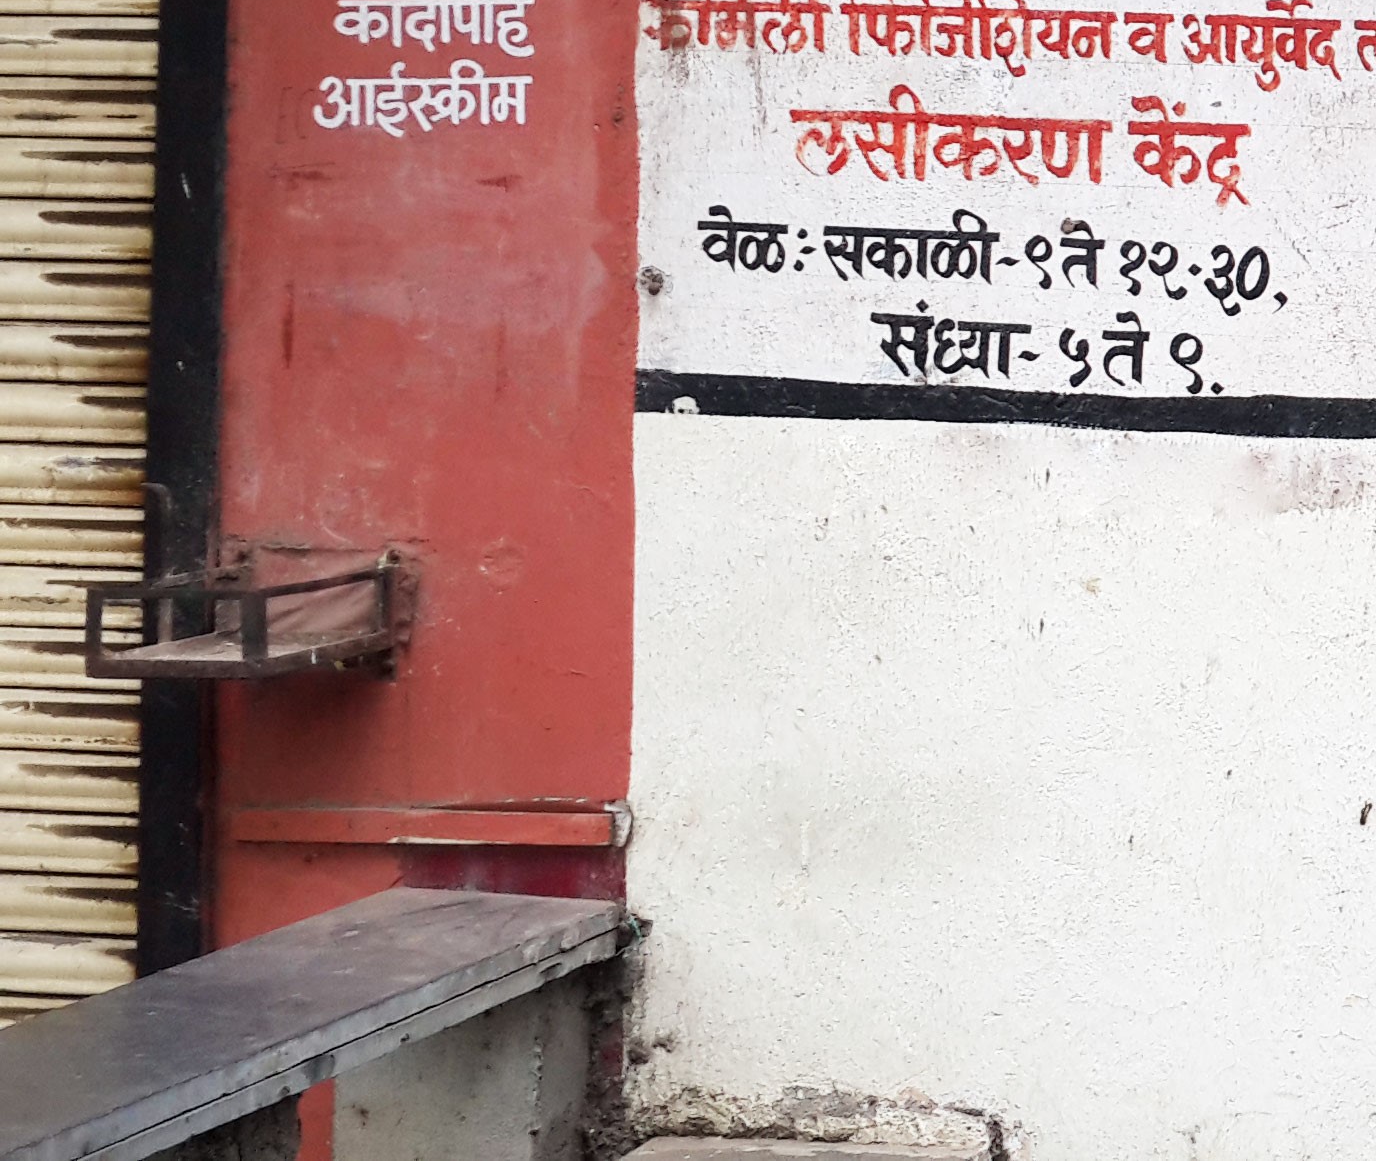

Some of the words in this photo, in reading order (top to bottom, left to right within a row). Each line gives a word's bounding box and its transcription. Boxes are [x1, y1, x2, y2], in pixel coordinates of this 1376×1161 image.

[1124, 12, 1174, 63] व
[790, 85, 1112, 183] लसीकरण
[1128, 96, 1251, 204] केंद्र
